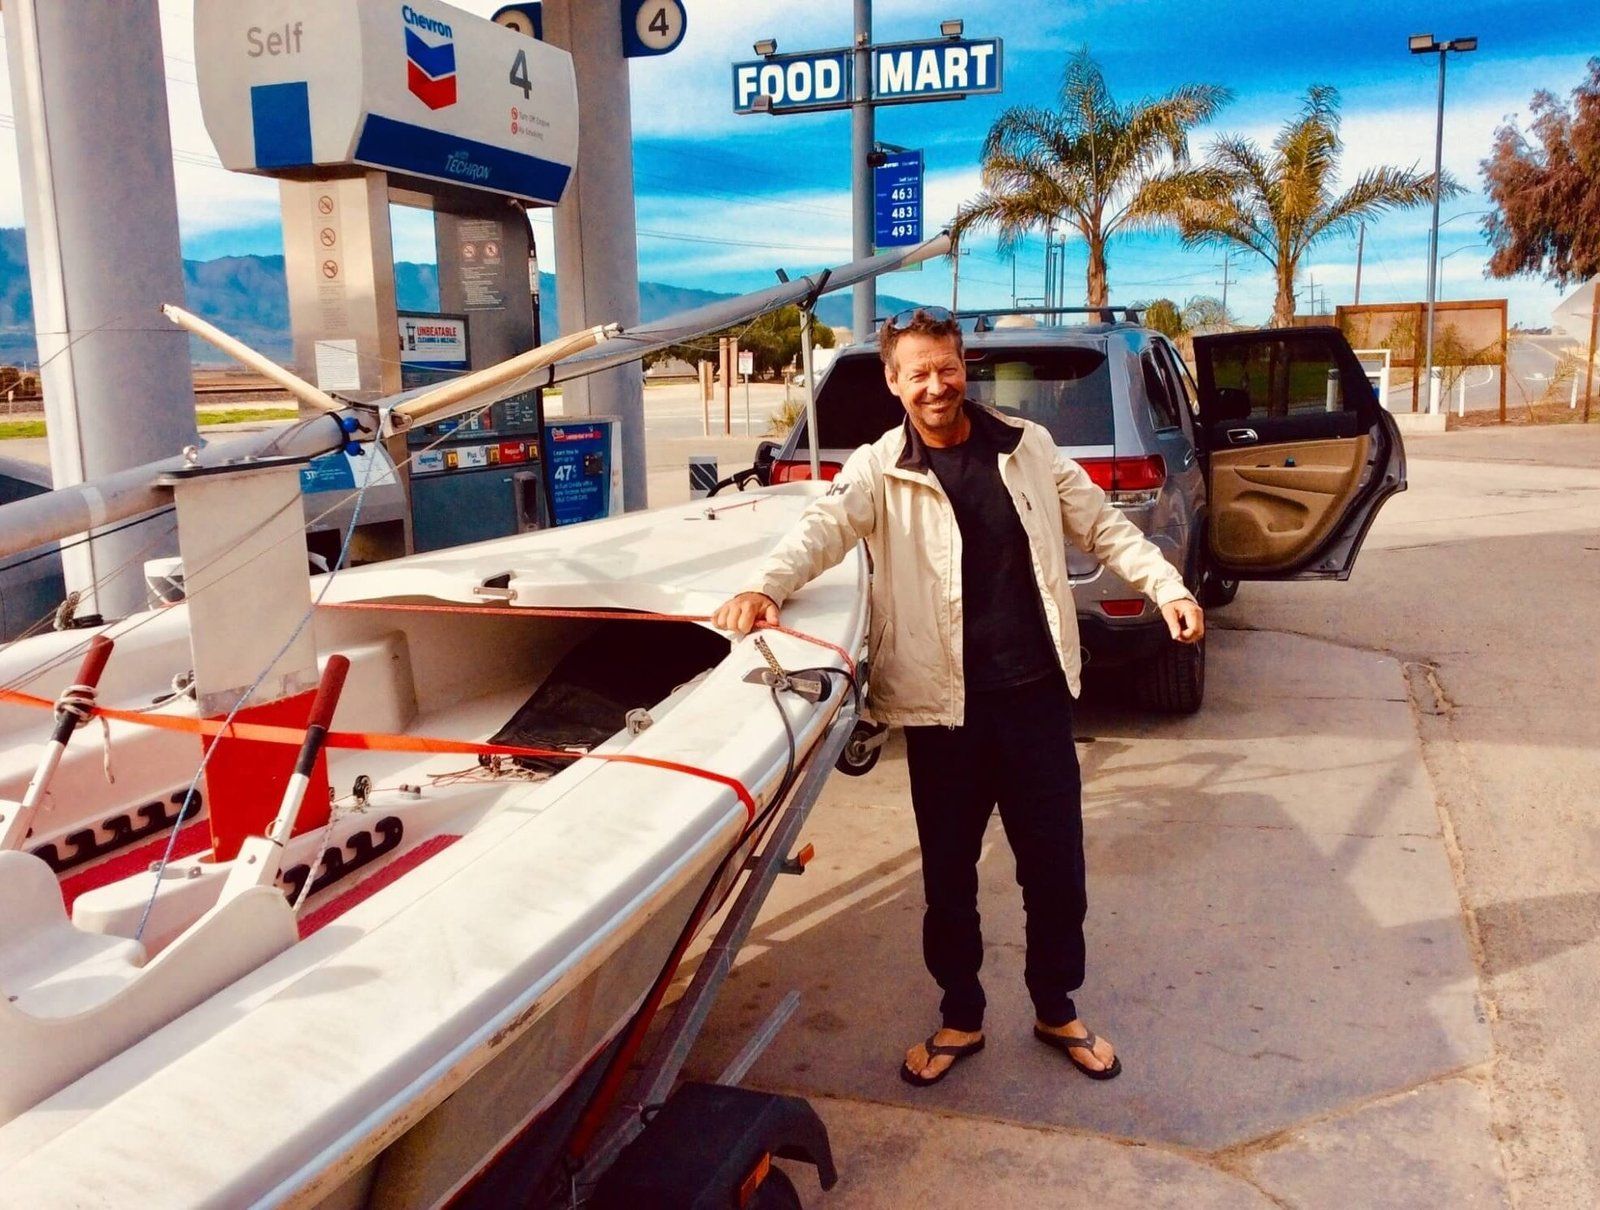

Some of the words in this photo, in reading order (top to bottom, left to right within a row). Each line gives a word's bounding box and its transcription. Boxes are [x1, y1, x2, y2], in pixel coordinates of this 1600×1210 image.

[402, 5, 453, 38] Chevron
[649, 8, 670, 37] 4
[246, 21, 303, 58] Self
[509, 49, 532, 100] 4
[738, 59, 841, 107] FOOD
[879, 44, 994, 94] MART
[445, 154, 491, 180] TECHRON
[892, 188, 912, 200] 463
[892, 206, 912, 218] 483
[892, 224, 912, 237] 493
[417, 326, 457, 337] UNBEATABLE
